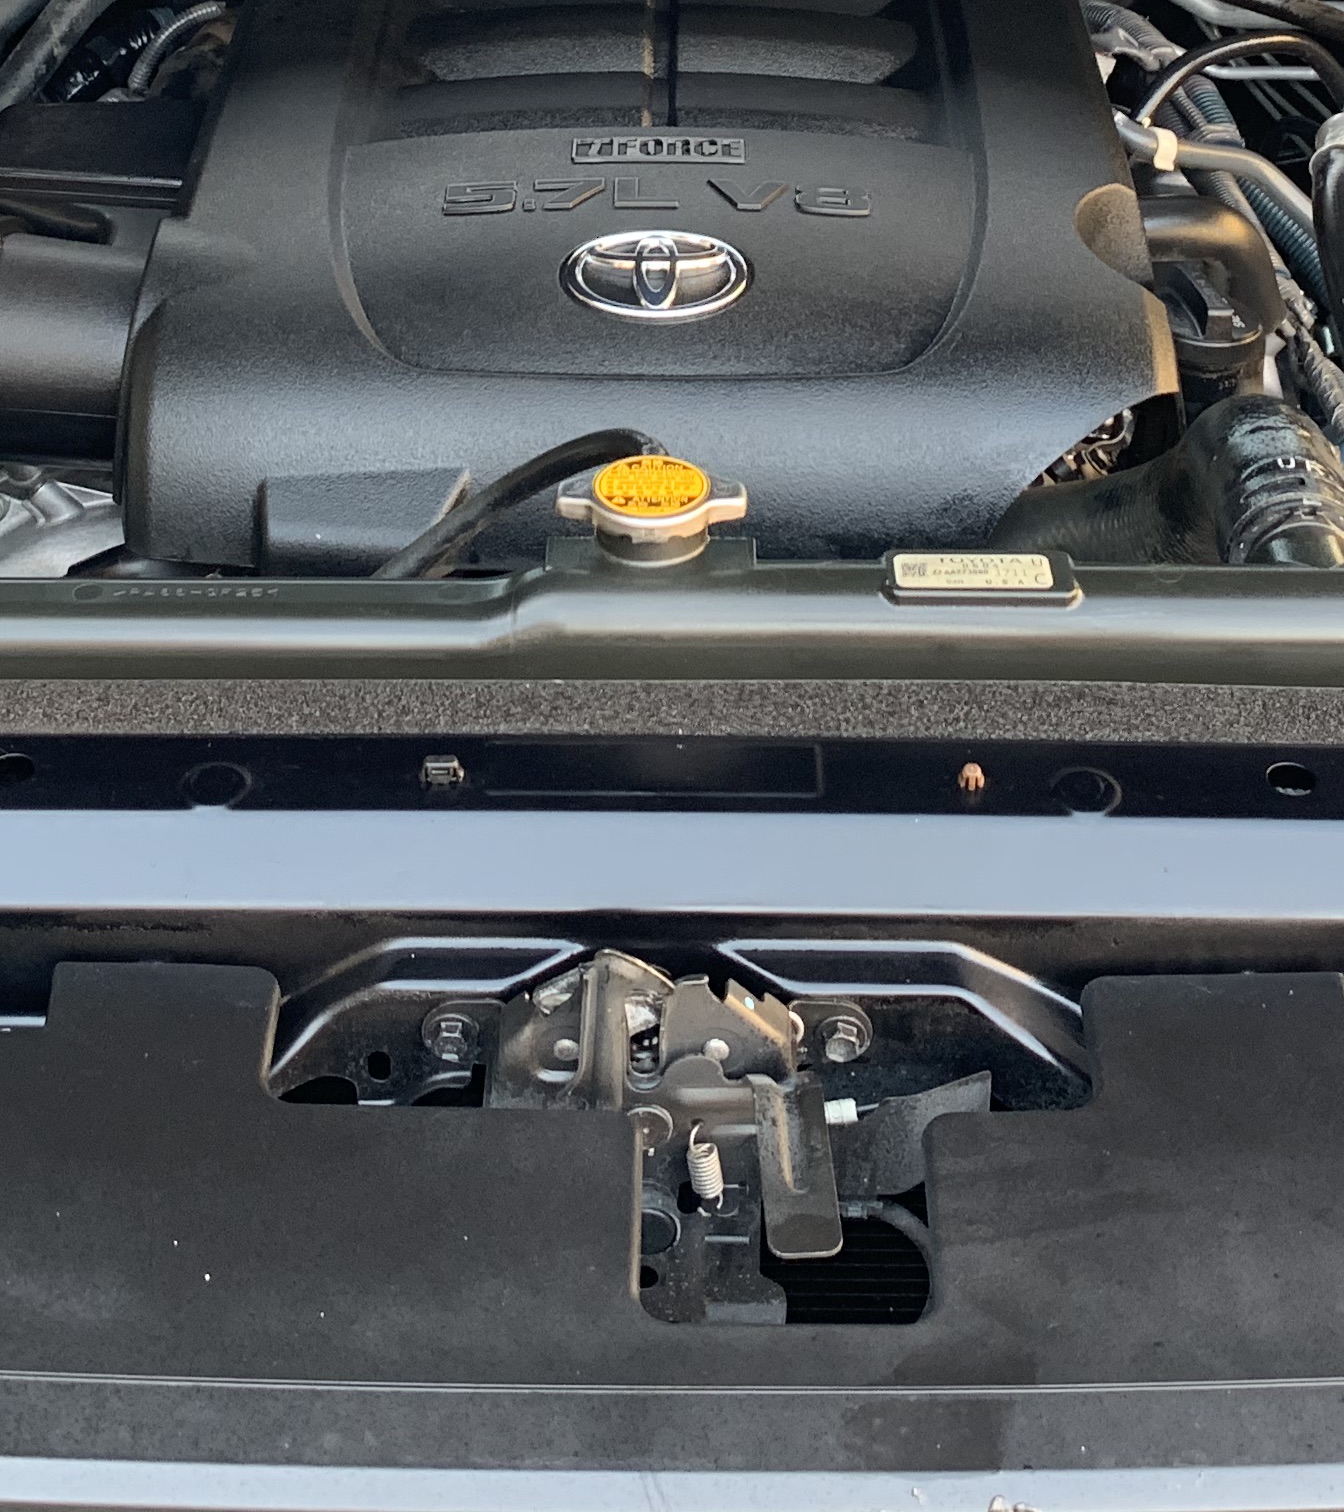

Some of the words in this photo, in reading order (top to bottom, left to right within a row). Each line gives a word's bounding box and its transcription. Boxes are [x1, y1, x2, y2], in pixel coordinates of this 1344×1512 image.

[443, 177, 680, 216] 5.7L
[707, 178, 873, 216] V8
[939, 557, 1023, 565] TOYOTA
